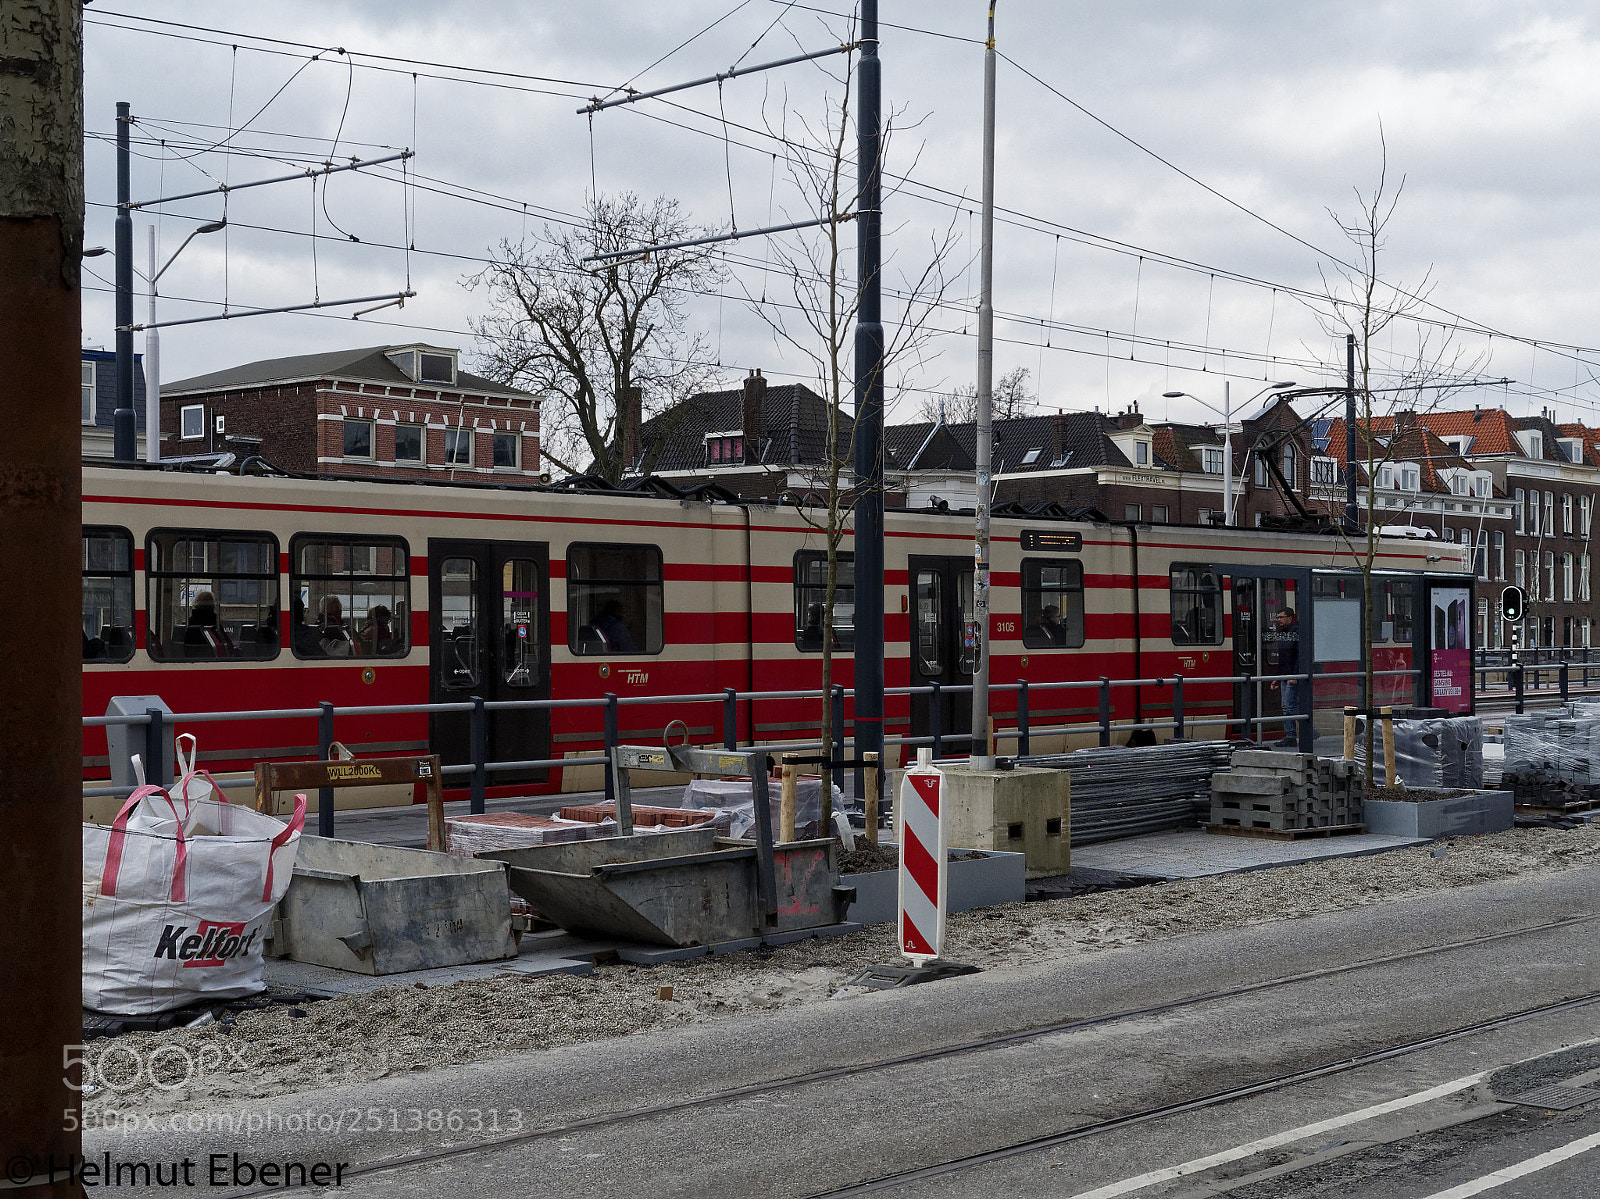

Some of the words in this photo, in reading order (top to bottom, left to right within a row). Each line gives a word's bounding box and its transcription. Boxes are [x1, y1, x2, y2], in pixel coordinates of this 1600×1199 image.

[997, 622, 1015, 632] 3105
[627, 673, 648, 683] HTM
[154, 924, 259, 960] Kelfort
